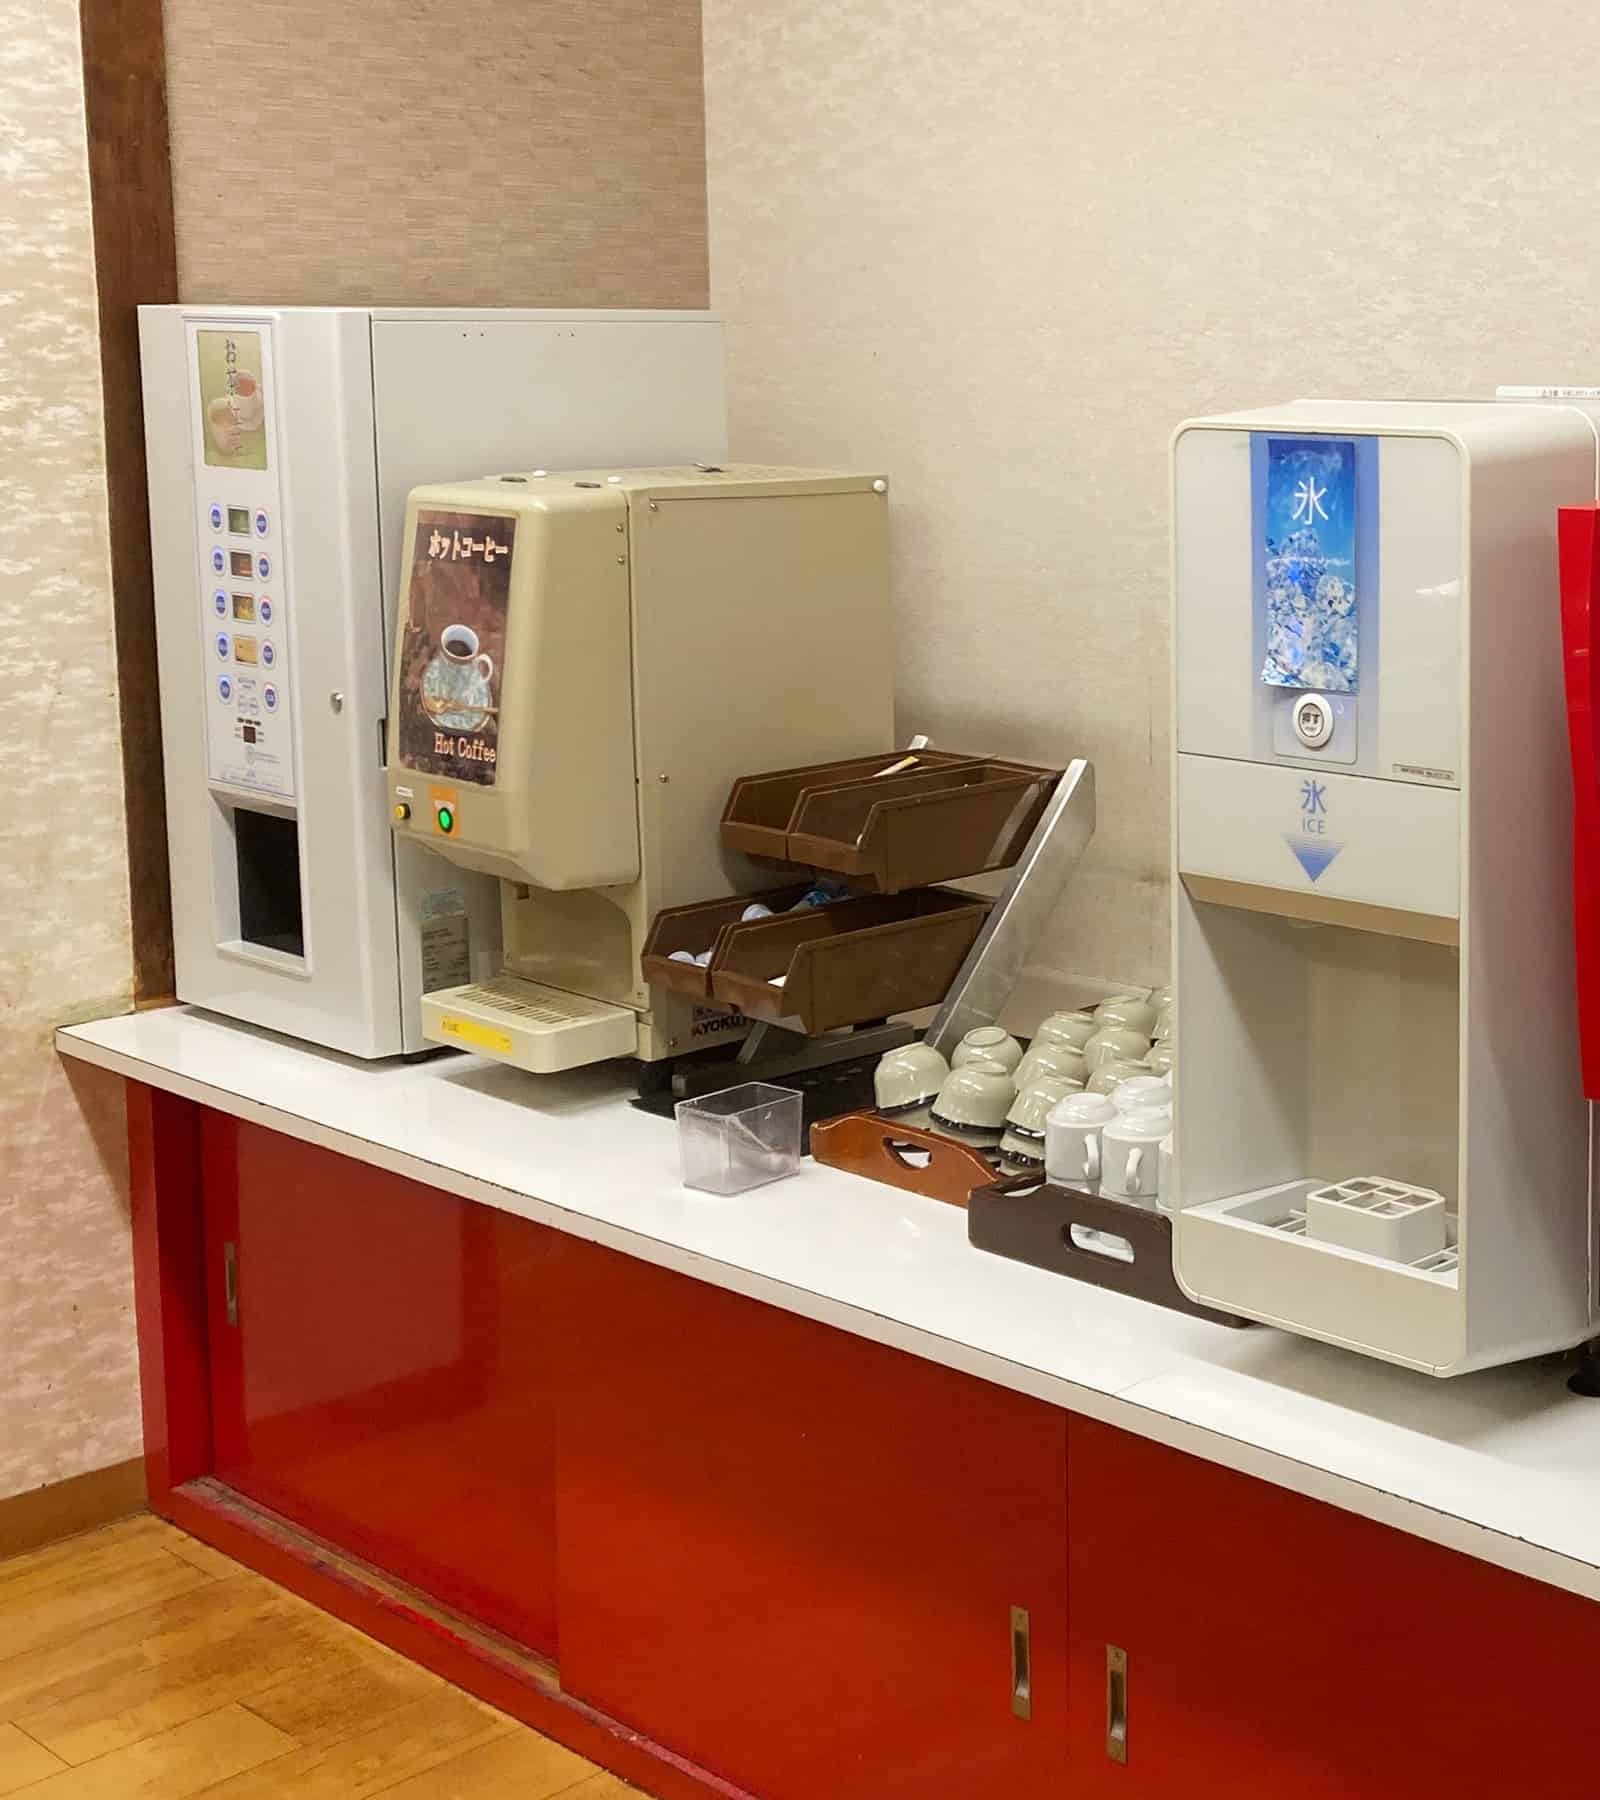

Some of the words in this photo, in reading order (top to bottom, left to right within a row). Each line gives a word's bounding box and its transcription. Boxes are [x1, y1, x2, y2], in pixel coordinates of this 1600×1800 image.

[1292, 476, 1329, 525] 氷
[428, 529, 508, 563] ホットコーヒー
[435, 732, 455, 756] Hot
[457, 736, 497, 763] Coffee
[1300, 779, 1328, 815] 氷
[1302, 817, 1326, 835] ICE
